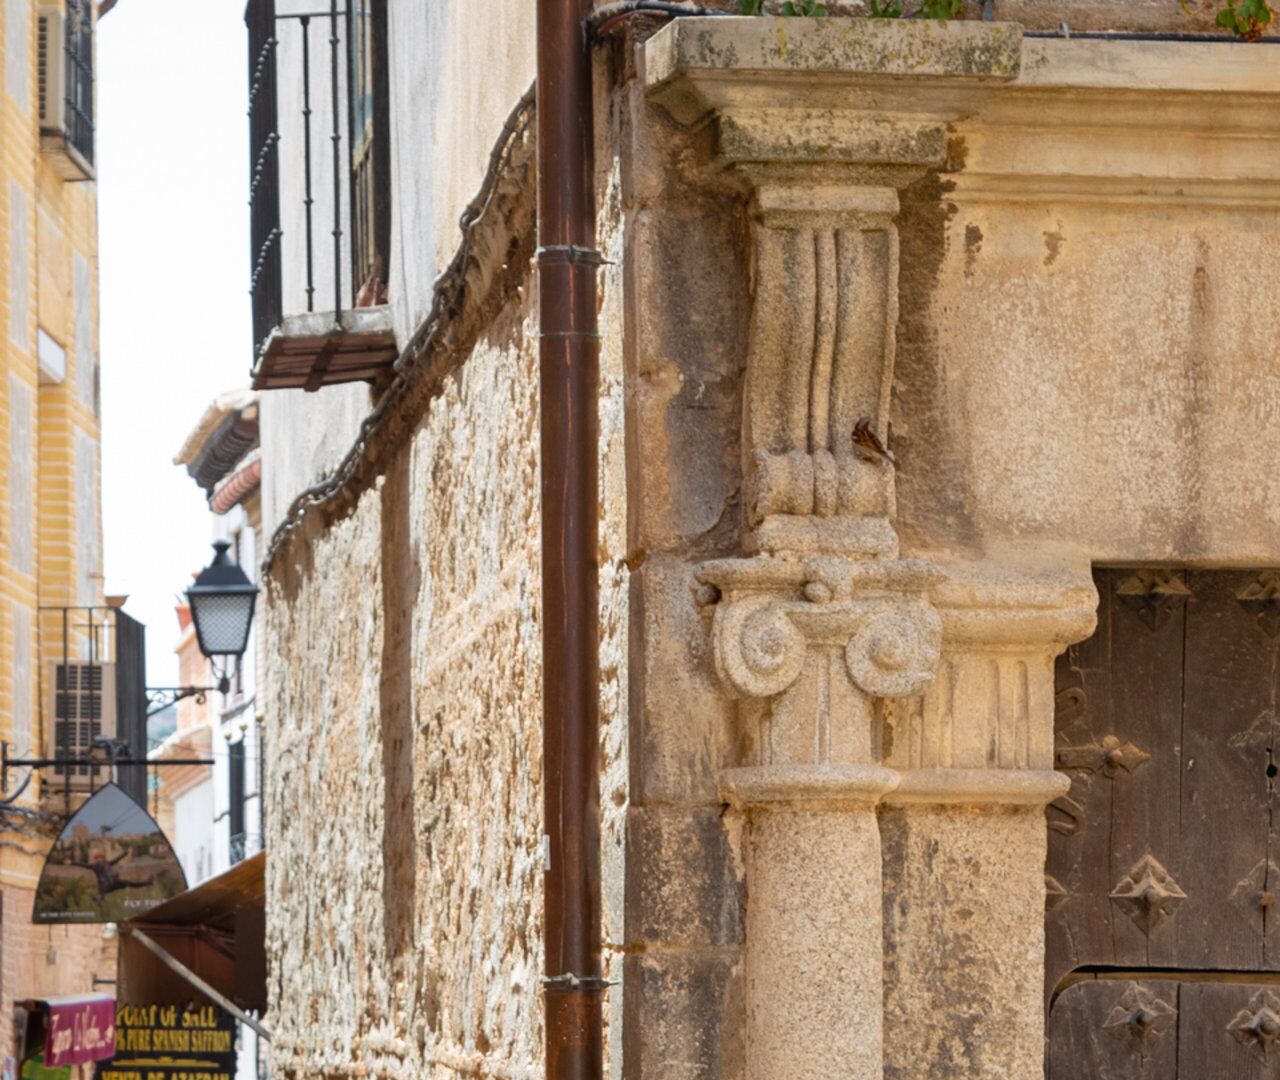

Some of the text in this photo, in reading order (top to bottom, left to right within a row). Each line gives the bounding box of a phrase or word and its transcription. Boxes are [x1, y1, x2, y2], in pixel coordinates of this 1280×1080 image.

[126, 1030, 151, 1052] PURE
[153, 1030, 190, 1052] SPANISH
[191, 1030, 232, 1052] SAFFRON
